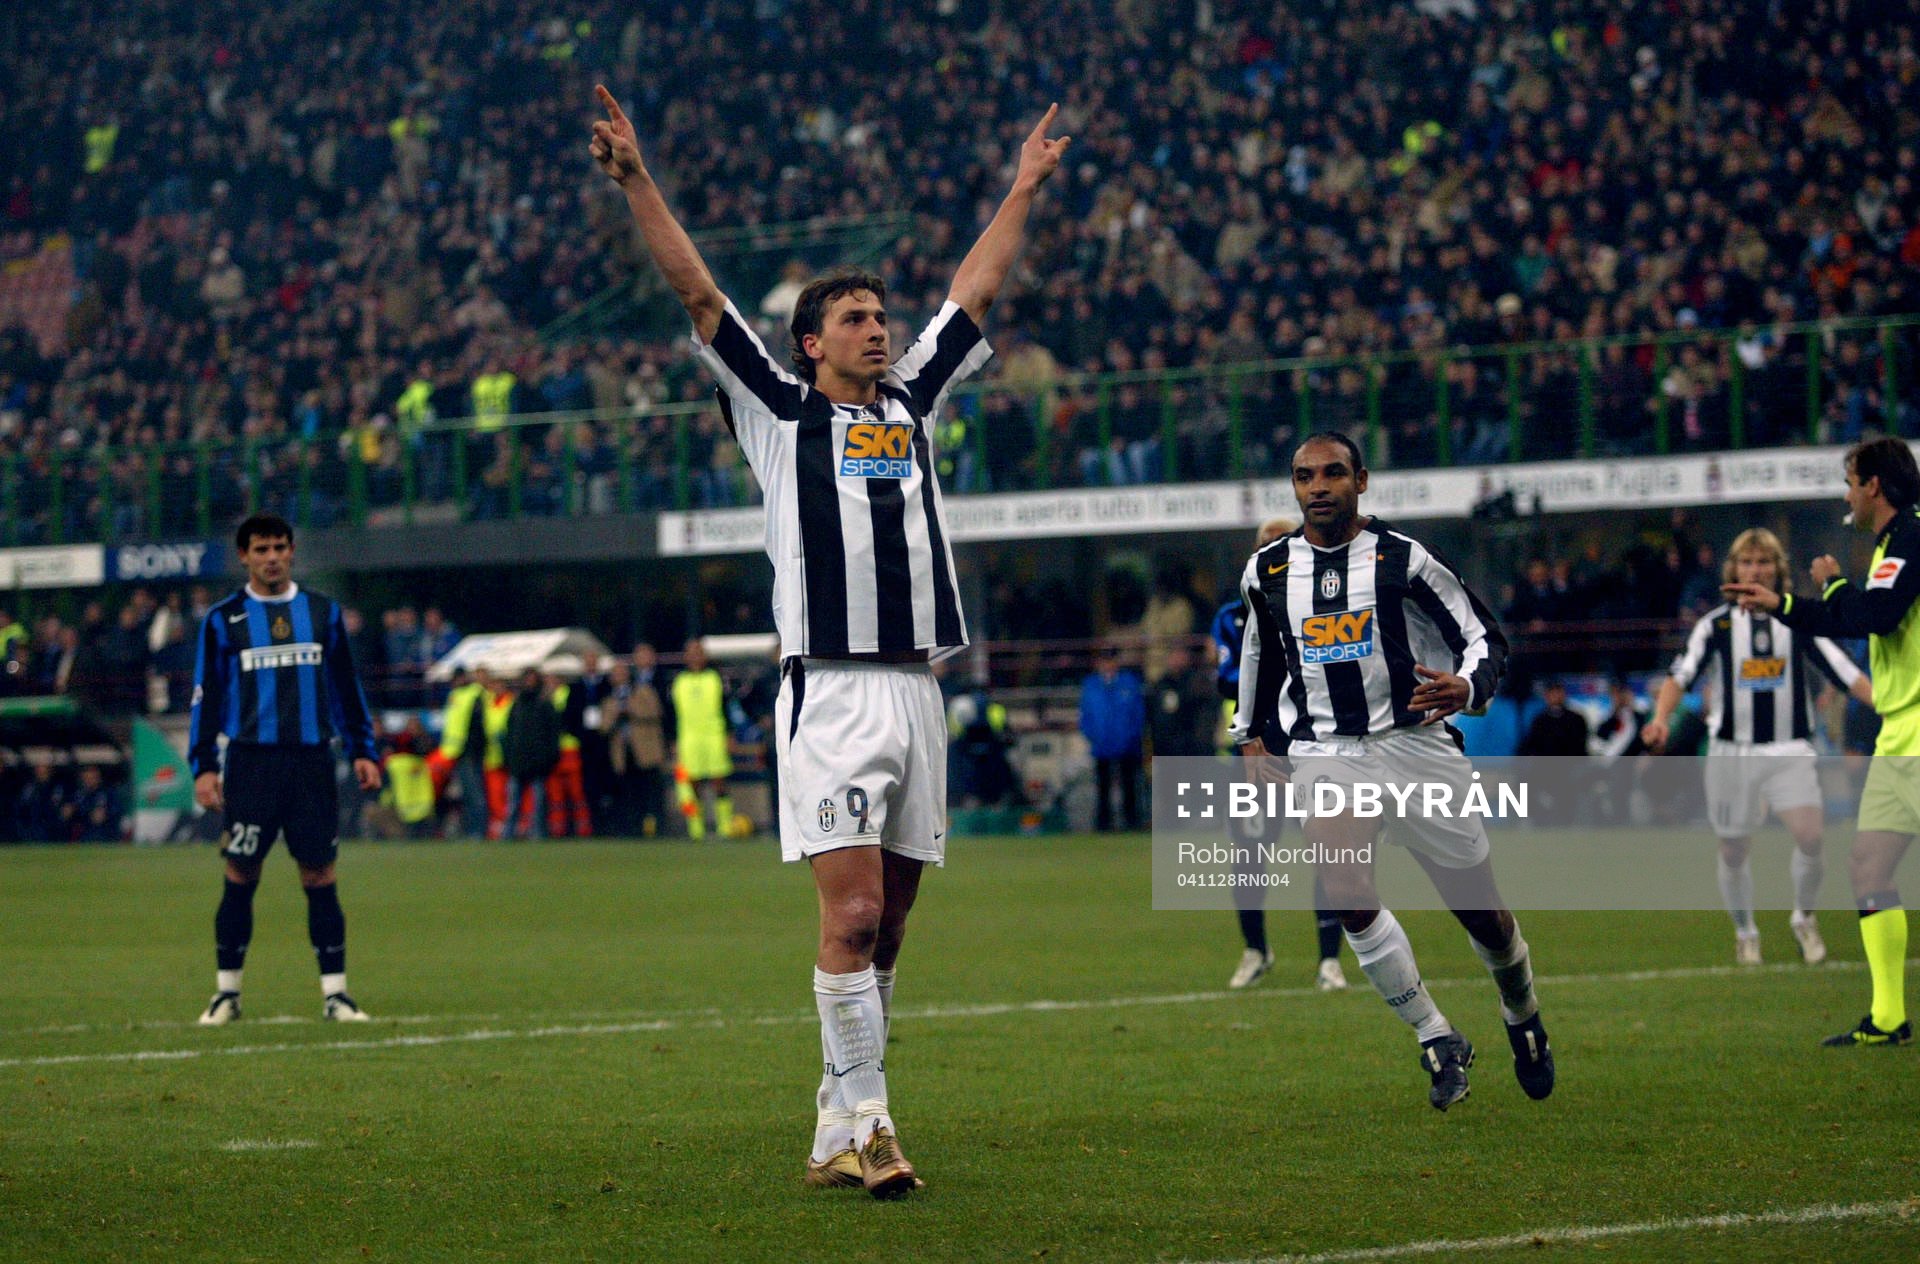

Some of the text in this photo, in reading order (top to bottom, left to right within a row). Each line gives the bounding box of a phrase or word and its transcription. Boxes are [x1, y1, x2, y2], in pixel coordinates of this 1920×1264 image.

[844, 424, 913, 458] SKY
[843, 460, 911, 476] SPORT
[116, 544, 206, 580] SONY
[1303, 611, 1372, 647] SKY
[1304, 641, 1371, 662] SPORT
[846, 788, 869, 833] 9
[228, 822, 261, 855] 25
